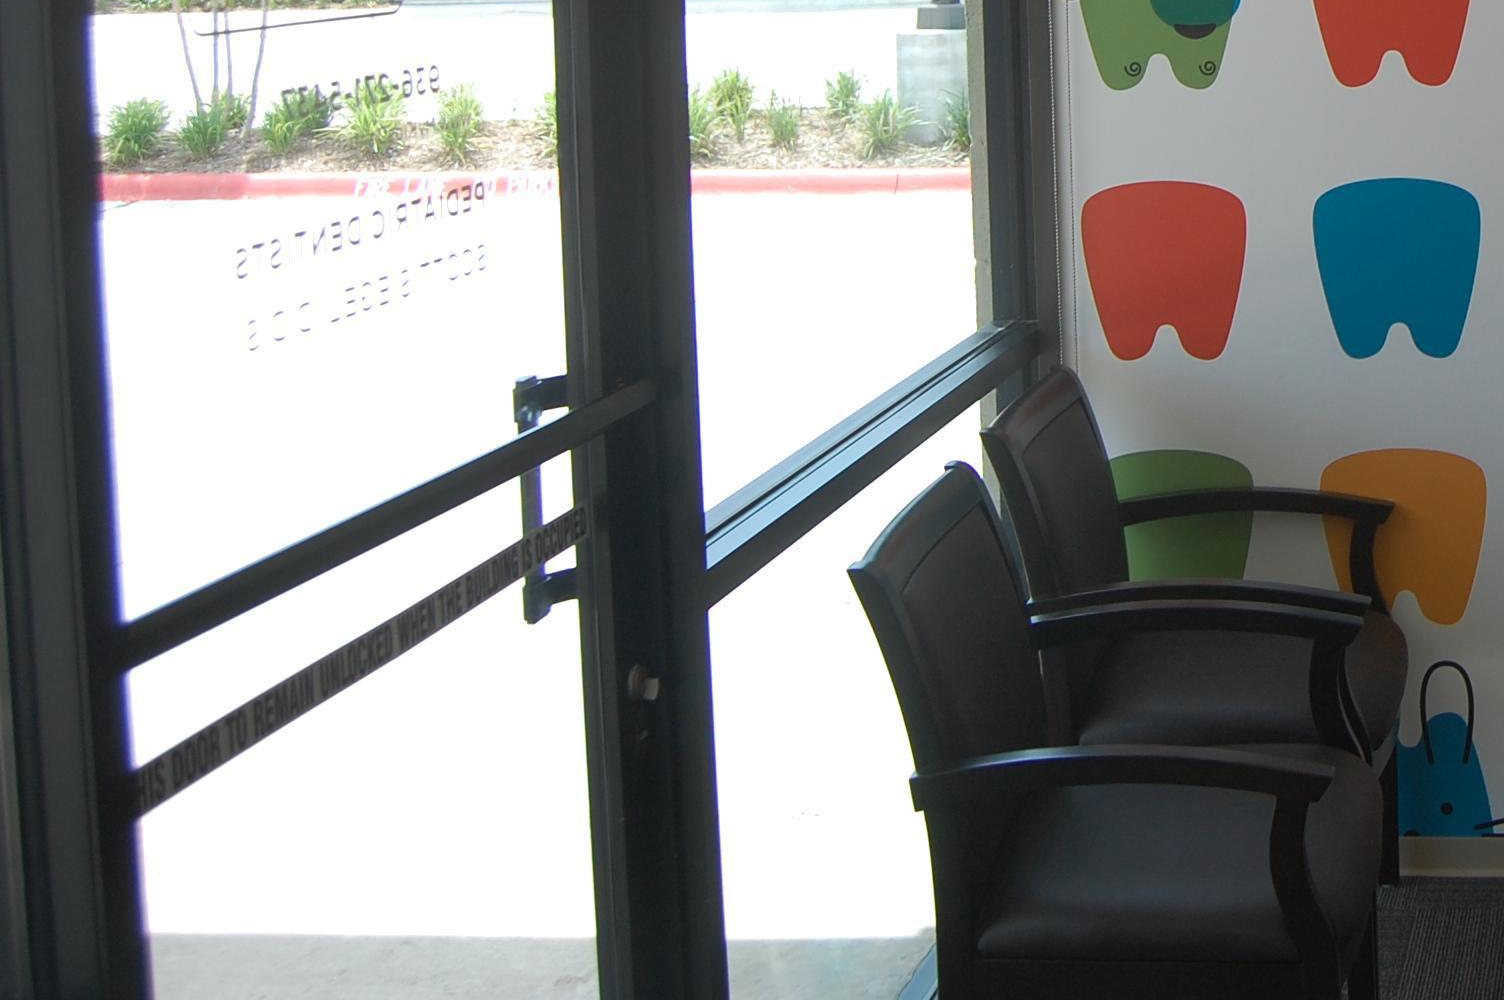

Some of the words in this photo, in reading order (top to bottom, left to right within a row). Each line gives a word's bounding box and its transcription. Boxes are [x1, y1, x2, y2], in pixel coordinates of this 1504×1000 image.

[136, 757, 166, 808] HIS
[171, 727, 220, 788] DOOR
[224, 709, 248, 755] TO
[253, 669, 315, 737] REMAIN
[319, 624, 393, 698] UNLOCKED
[396, 598, 436, 648] WHEN
[440, 580, 464, 622] THE
[465, 547, 519, 608] BUILDING
[521, 538, 532, 572] IS
[535, 506, 586, 564] OCCUPIED
